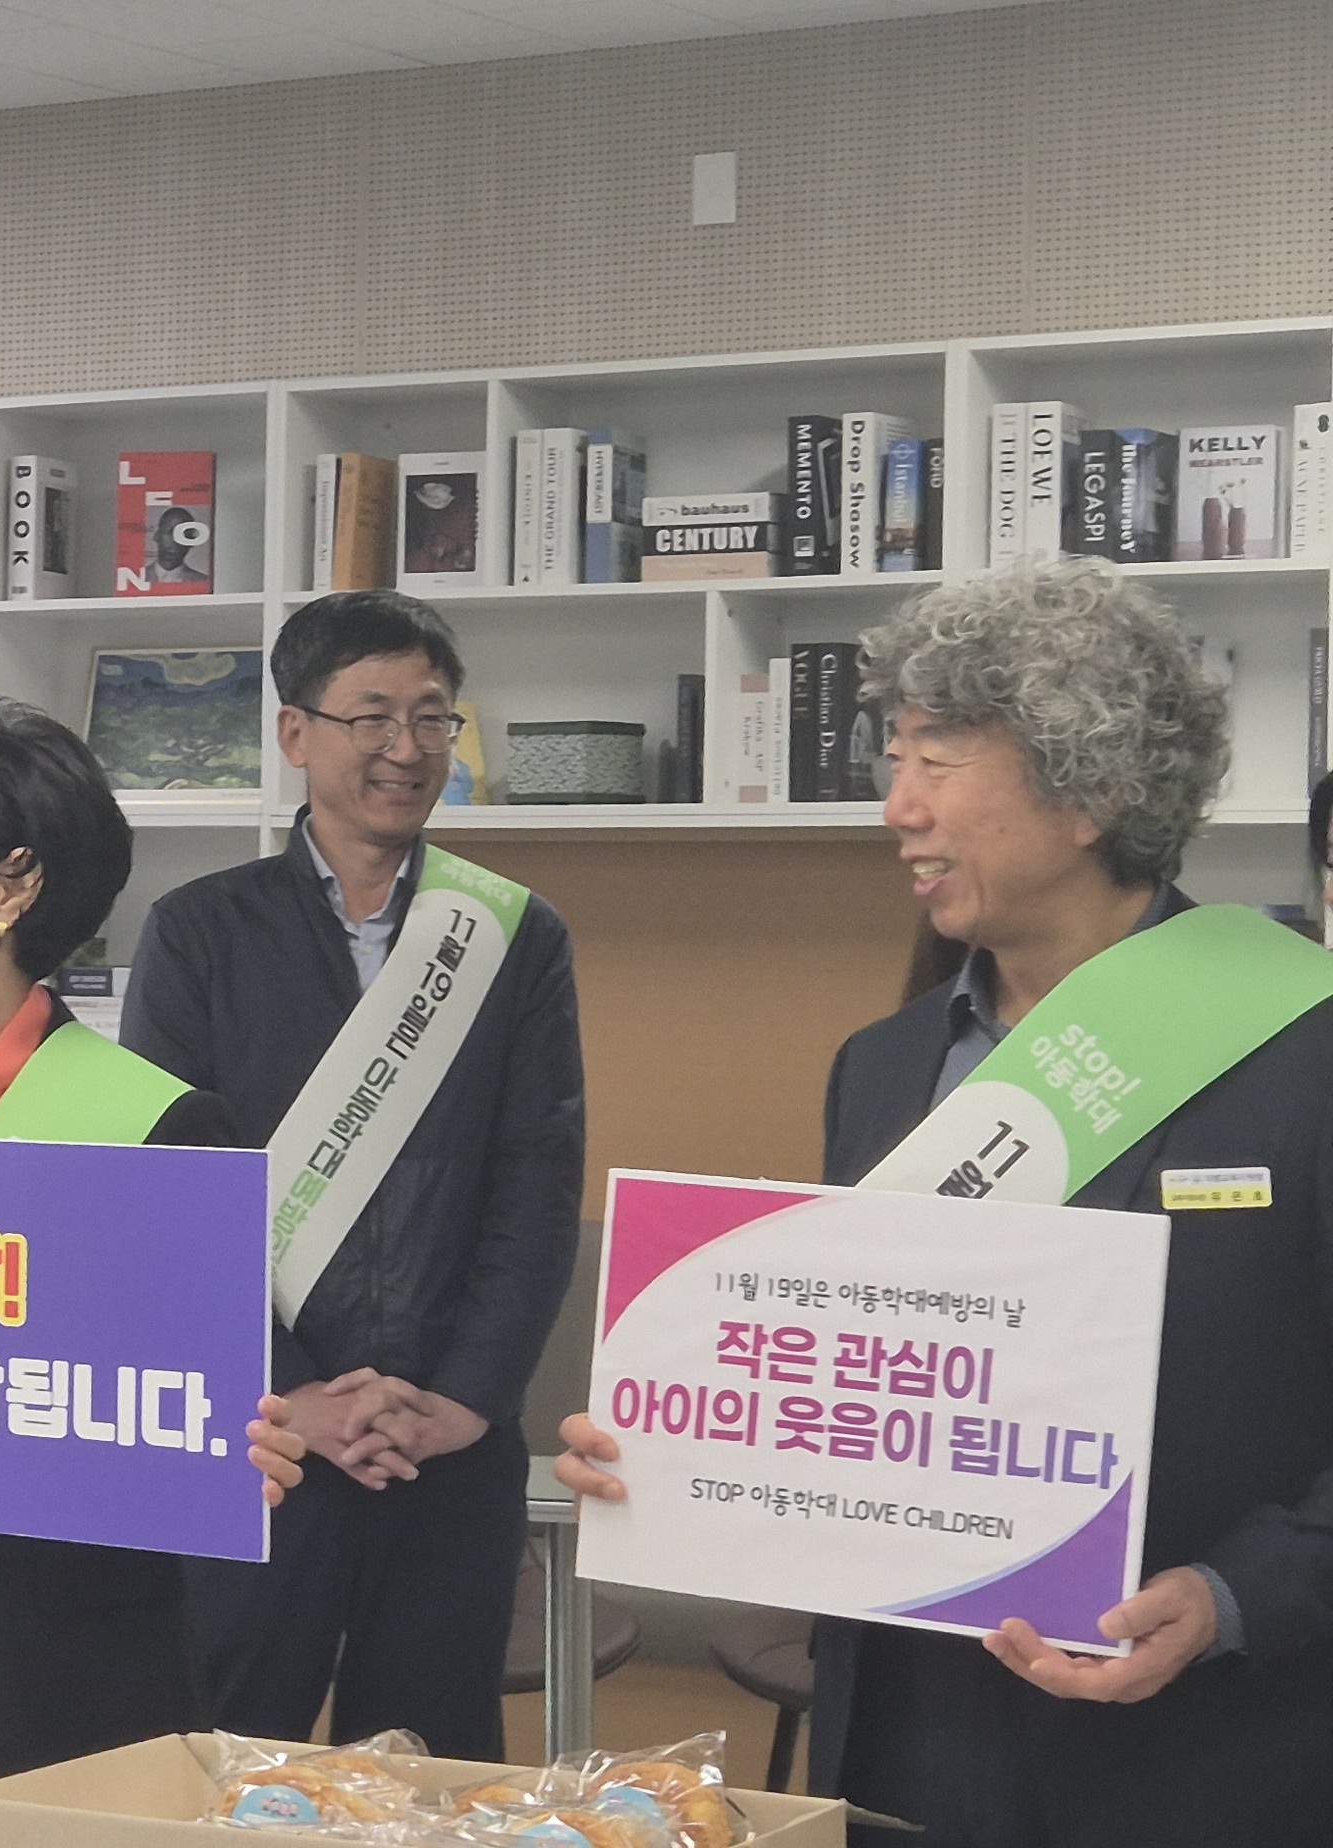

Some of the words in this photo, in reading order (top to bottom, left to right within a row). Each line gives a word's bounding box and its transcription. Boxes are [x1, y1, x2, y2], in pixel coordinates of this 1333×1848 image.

[547, 446, 557, 484] TOUR
[795, 424, 813, 519] MEMENTO
[847, 420, 865, 474] Drop
[1001, 432, 1016, 483] THE
[1031, 412, 1055, 508] LOEWE
[1189, 435, 1267, 453] KELLY
[545, 490, 557, 544] GRAND
[680, 502, 749, 517] bauhaus
[998, 489, 1016, 539] DOG
[1083, 451, 1107, 543] LEGASPI
[655, 526, 758, 553] CENTURY
[819, 653, 837, 725] Christian
[819, 731, 836, 769] Dior
[435, 908, 477, 972] 11월
[385, 961, 453, 1060] 19일은
[1029, 1036, 1124, 1136] 아동학대
[1059, 1023, 1142, 1103] stop!
[714, 1271, 760, 1301] 11월
[765, 1278, 832, 1309] 19일은
[1001, 1296, 1027, 1329] 날
[716, 1320, 817, 1384] 작은
[833, 1332, 994, 1404] 관심이
[611, 1376, 761, 1446] 아이의
[774, 1393, 934, 1467] 웃음이
[947, 1414, 1119, 1490] 됩니다
[690, 1477, 745, 1504] STOP
[749, 1487, 838, 1519] 아동학대
[841, 1502, 899, 1525] LOVE
[902, 1506, 1015, 1540] CHILDREN
